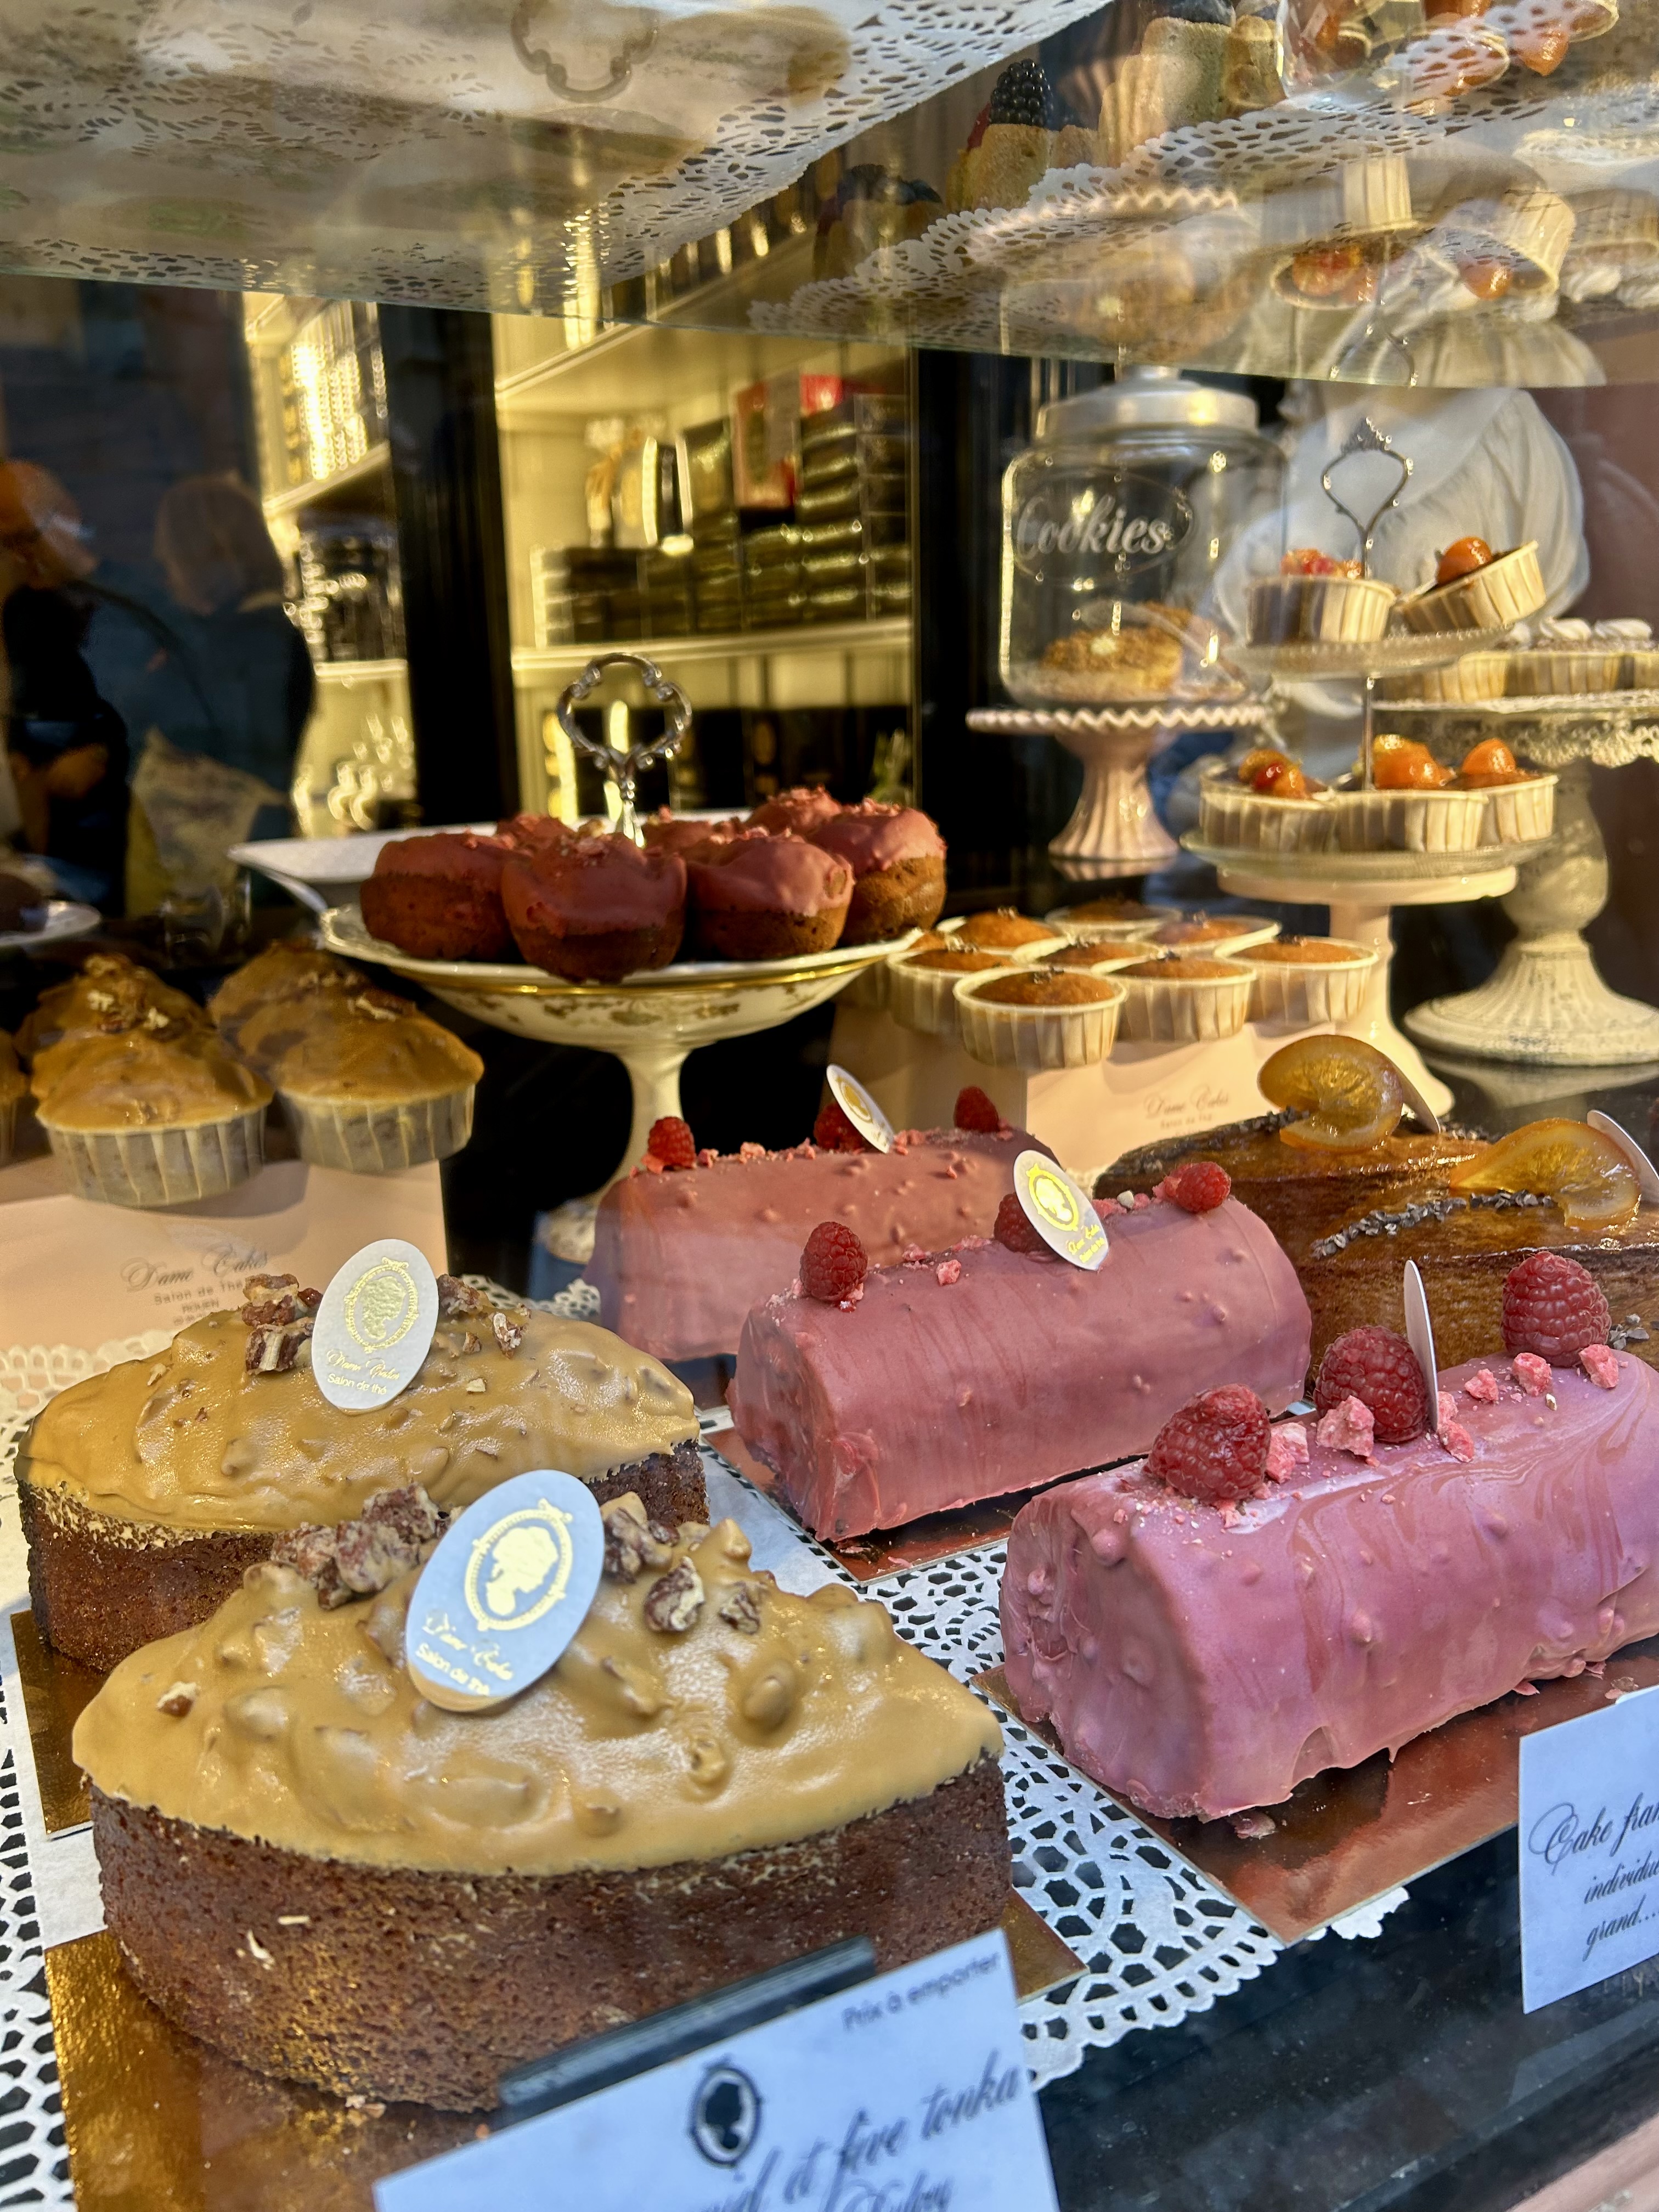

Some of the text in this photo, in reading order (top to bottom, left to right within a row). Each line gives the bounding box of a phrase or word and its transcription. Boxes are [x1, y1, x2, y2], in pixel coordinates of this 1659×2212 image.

[1016, 493, 1167, 561] Cookies
[1143, 1083, 1229, 1119] Dame Cakes
[120, 1242, 268, 1293] Dame Cakes
[154, 1290, 192, 1306] Salon
[198, 1285, 214, 1298] de
[326, 1348, 399, 1379] Dame Cakes
[327, 1373, 355, 1387] Salon
[357, 1380, 370, 1391] de
[1528, 1803, 1613, 1876] Cake
[842, 1952, 1001, 2031] Prix à emporter
[921, 2047, 1024, 2138] tonka
